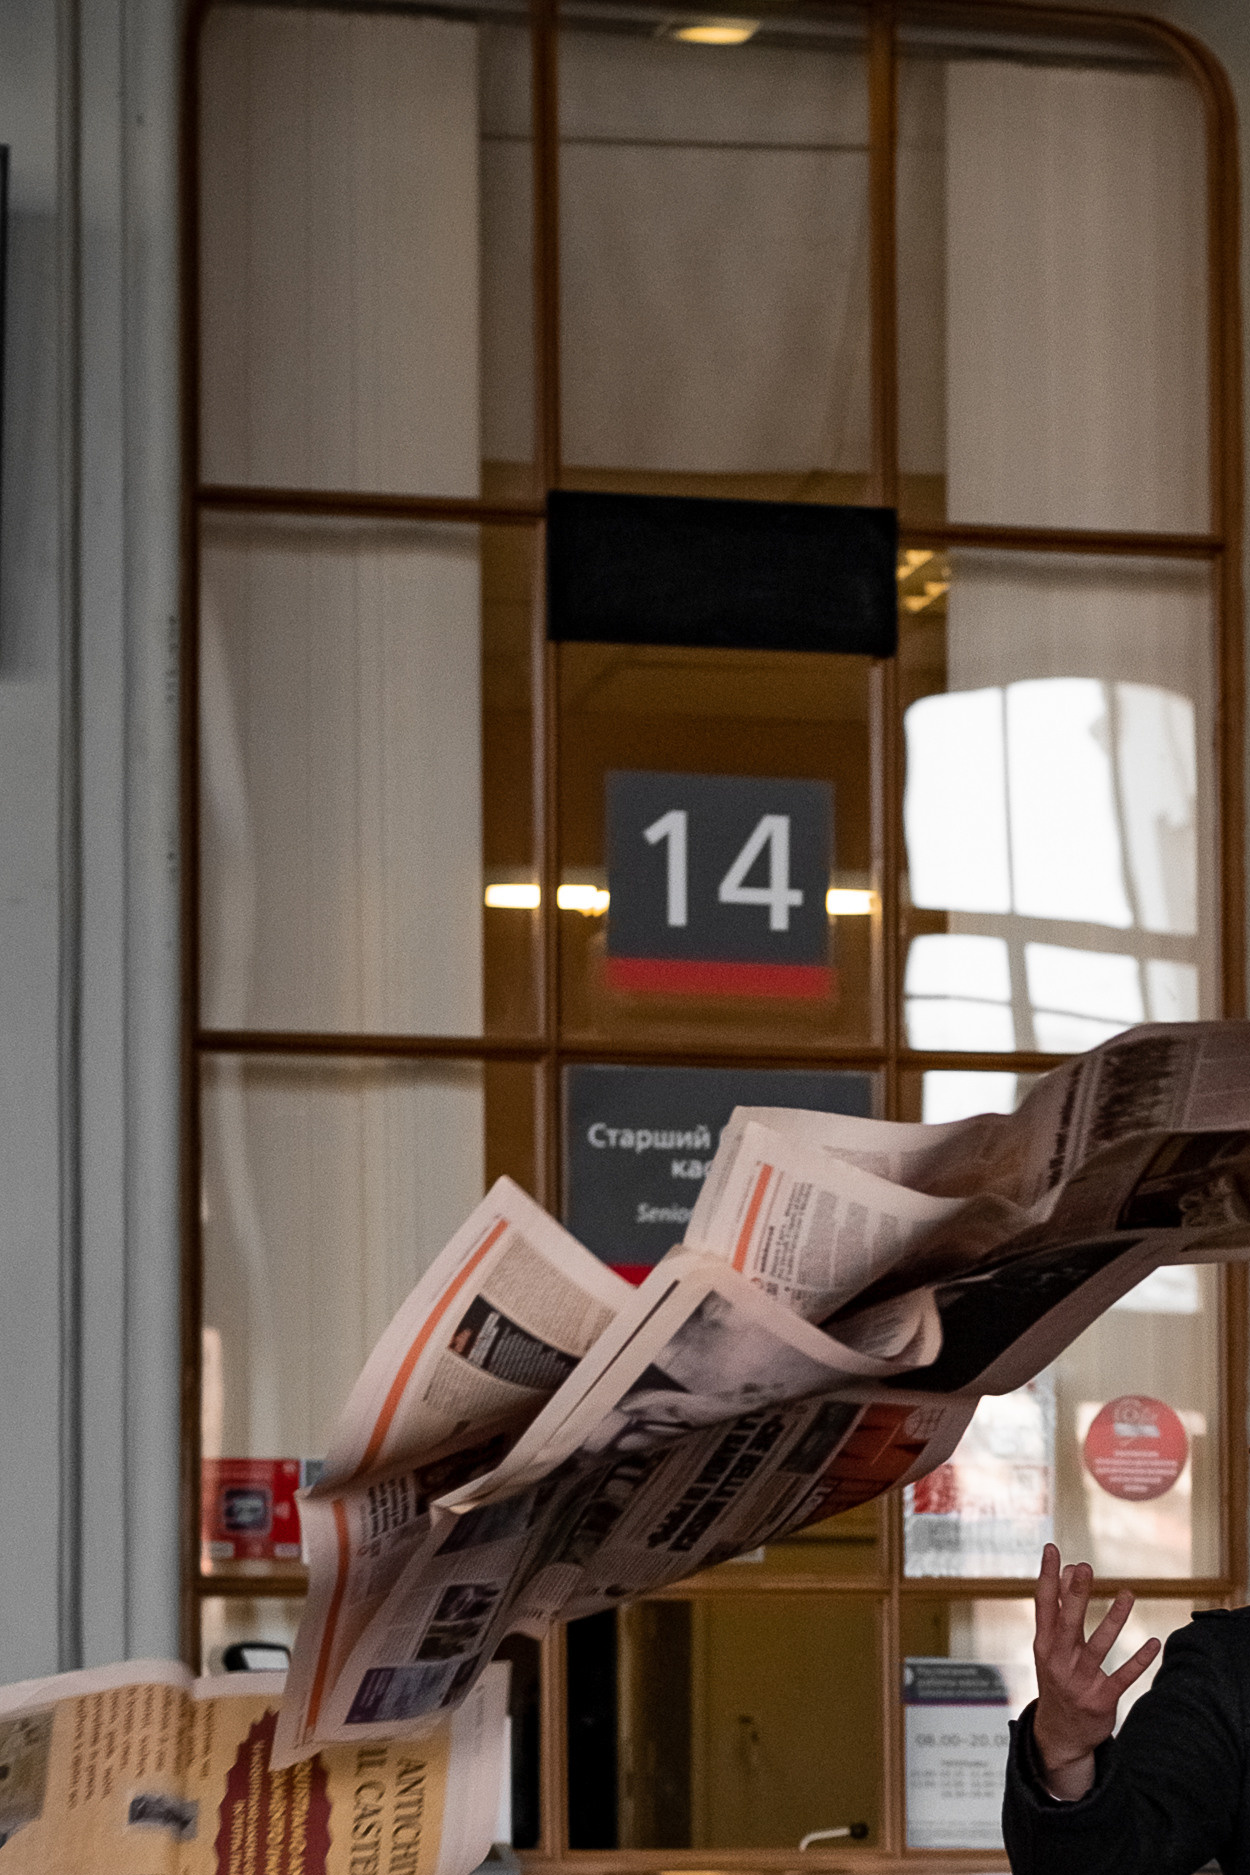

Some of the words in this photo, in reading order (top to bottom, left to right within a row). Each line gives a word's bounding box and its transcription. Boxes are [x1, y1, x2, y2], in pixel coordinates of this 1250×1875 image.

[643, 809, 804, 932] 14
[587, 1121, 711, 1153] Старший
[637, 1202, 693, 1223] Senio
